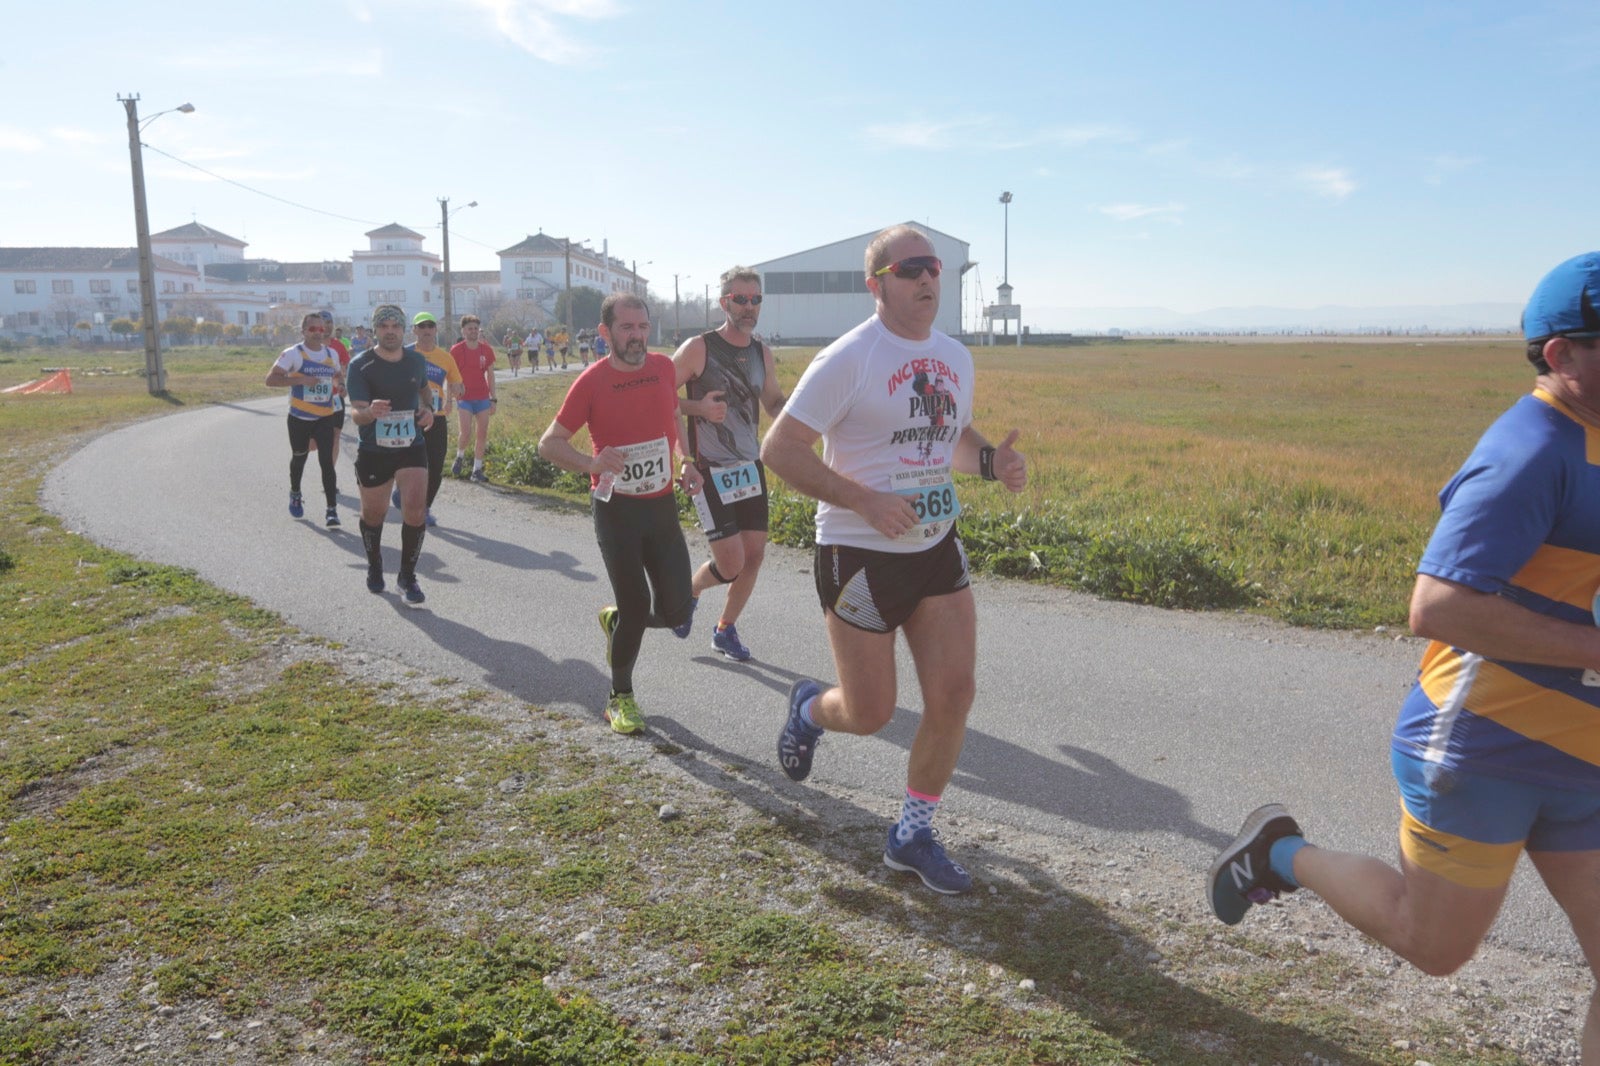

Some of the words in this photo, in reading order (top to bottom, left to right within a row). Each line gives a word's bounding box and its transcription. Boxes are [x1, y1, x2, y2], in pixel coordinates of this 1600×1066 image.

[309, 385, 328, 395] 498
[384, 422, 410, 436] 711
[621, 456, 664, 482] 3021
[722, 468, 750, 489] 671
[911, 488, 953, 519] 669
[1230, 853, 1254, 888] N
